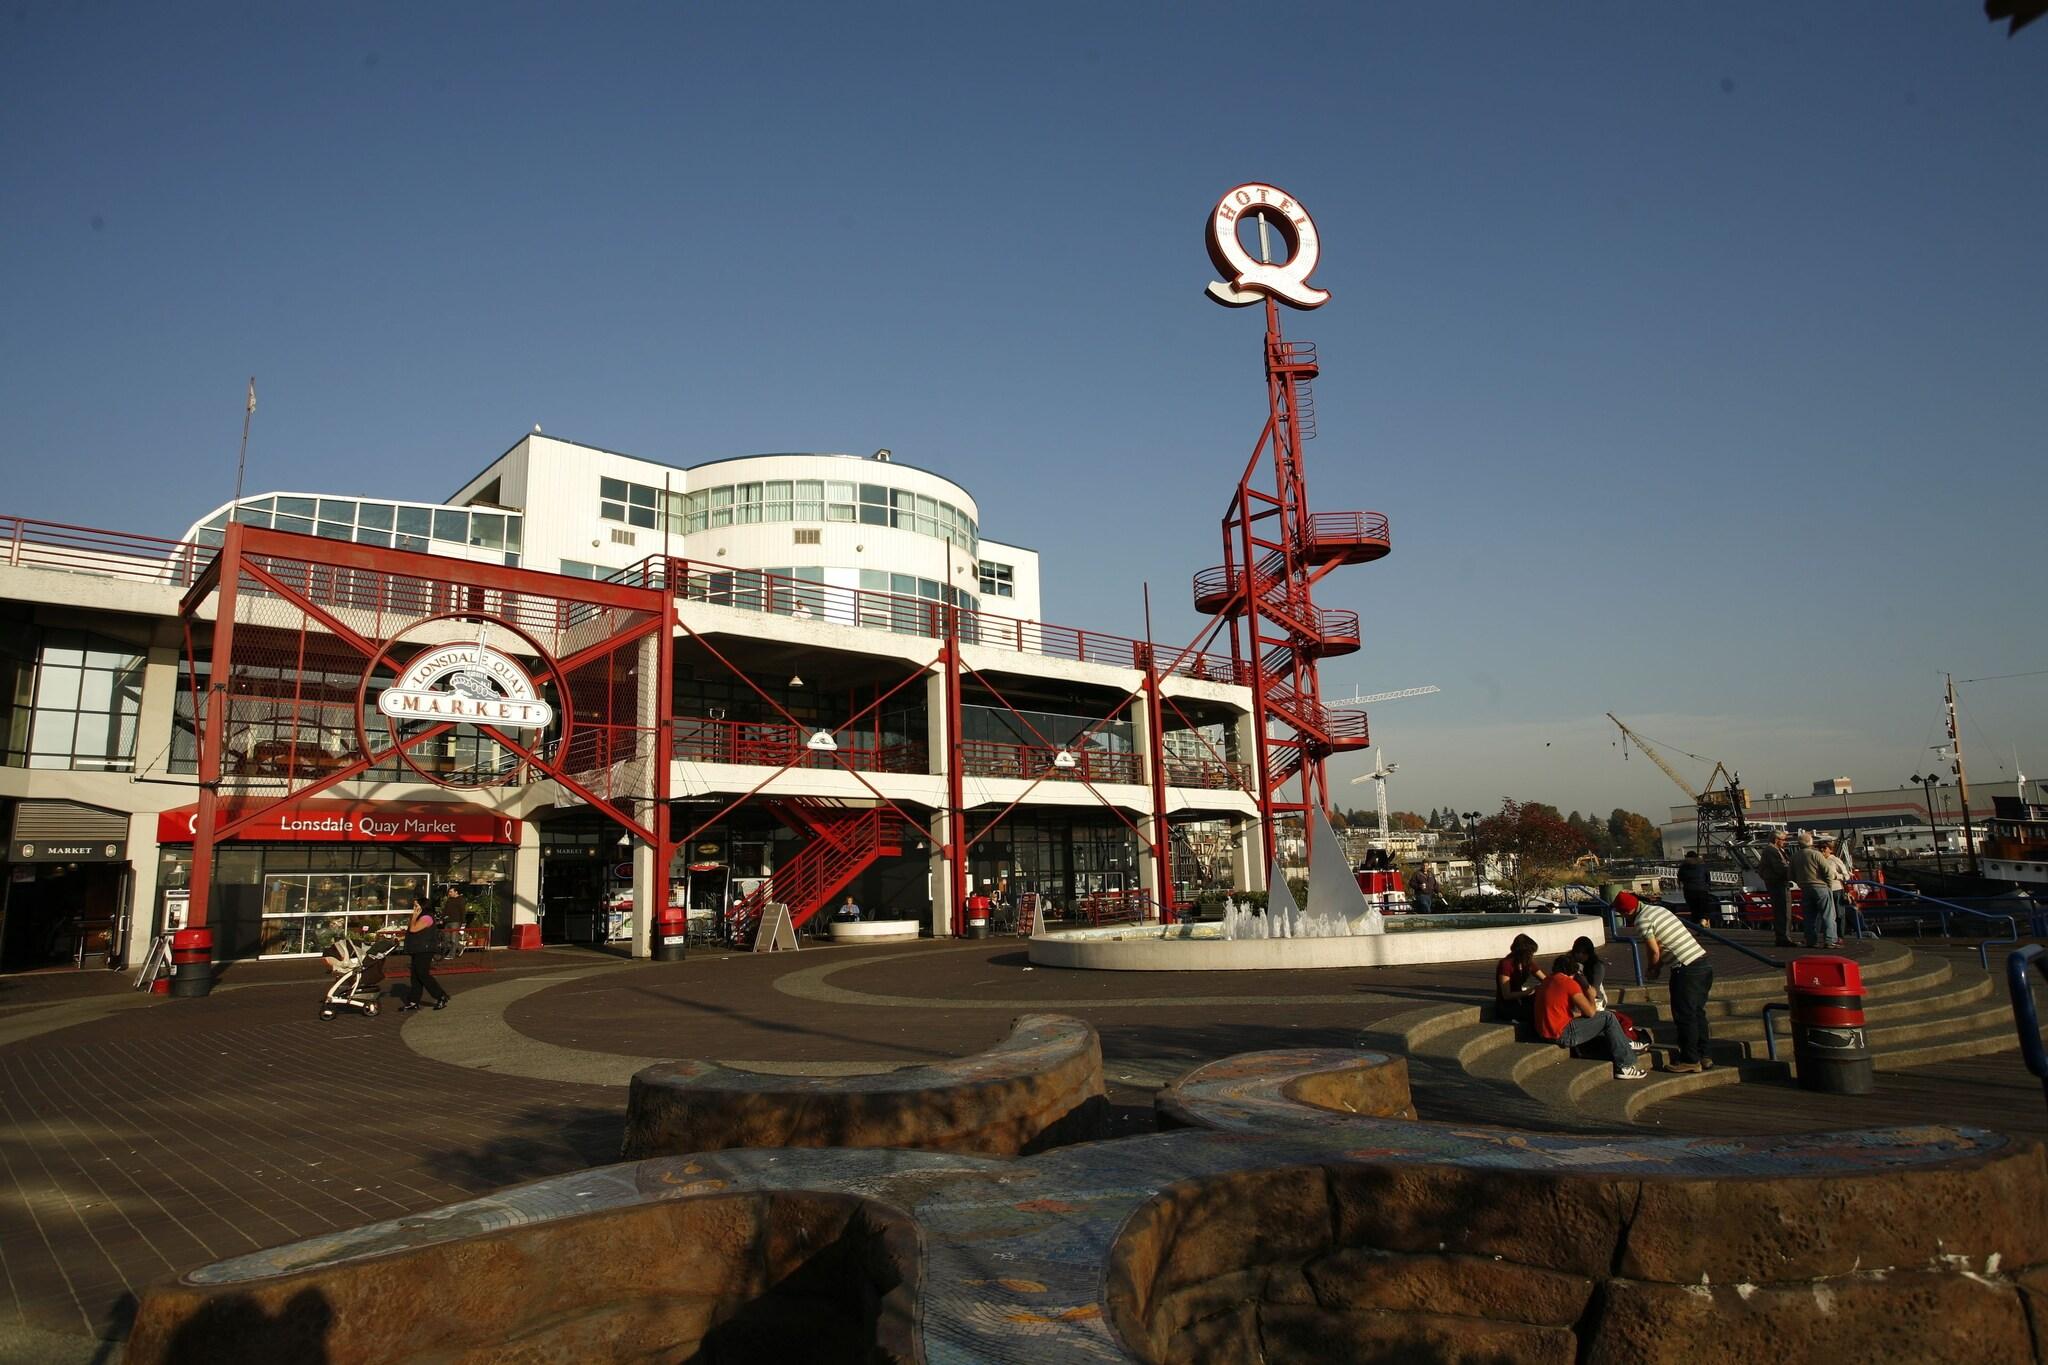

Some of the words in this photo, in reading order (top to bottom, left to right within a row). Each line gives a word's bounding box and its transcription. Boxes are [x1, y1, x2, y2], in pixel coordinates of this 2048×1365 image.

[1219, 188, 1307, 232] HOTEL
[1205, 182, 1332, 311] Q
[413, 651, 489, 686] LONSDALE
[493, 661, 526, 693] QUAY
[402, 695, 533, 720] MARKET
[281, 816, 353, 831] Lonsdale
[359, 817, 400, 837] Quay
[404, 819, 456, 833] Market
[505, 820, 513, 842] Q
[47, 847, 92, 855] MARKET
